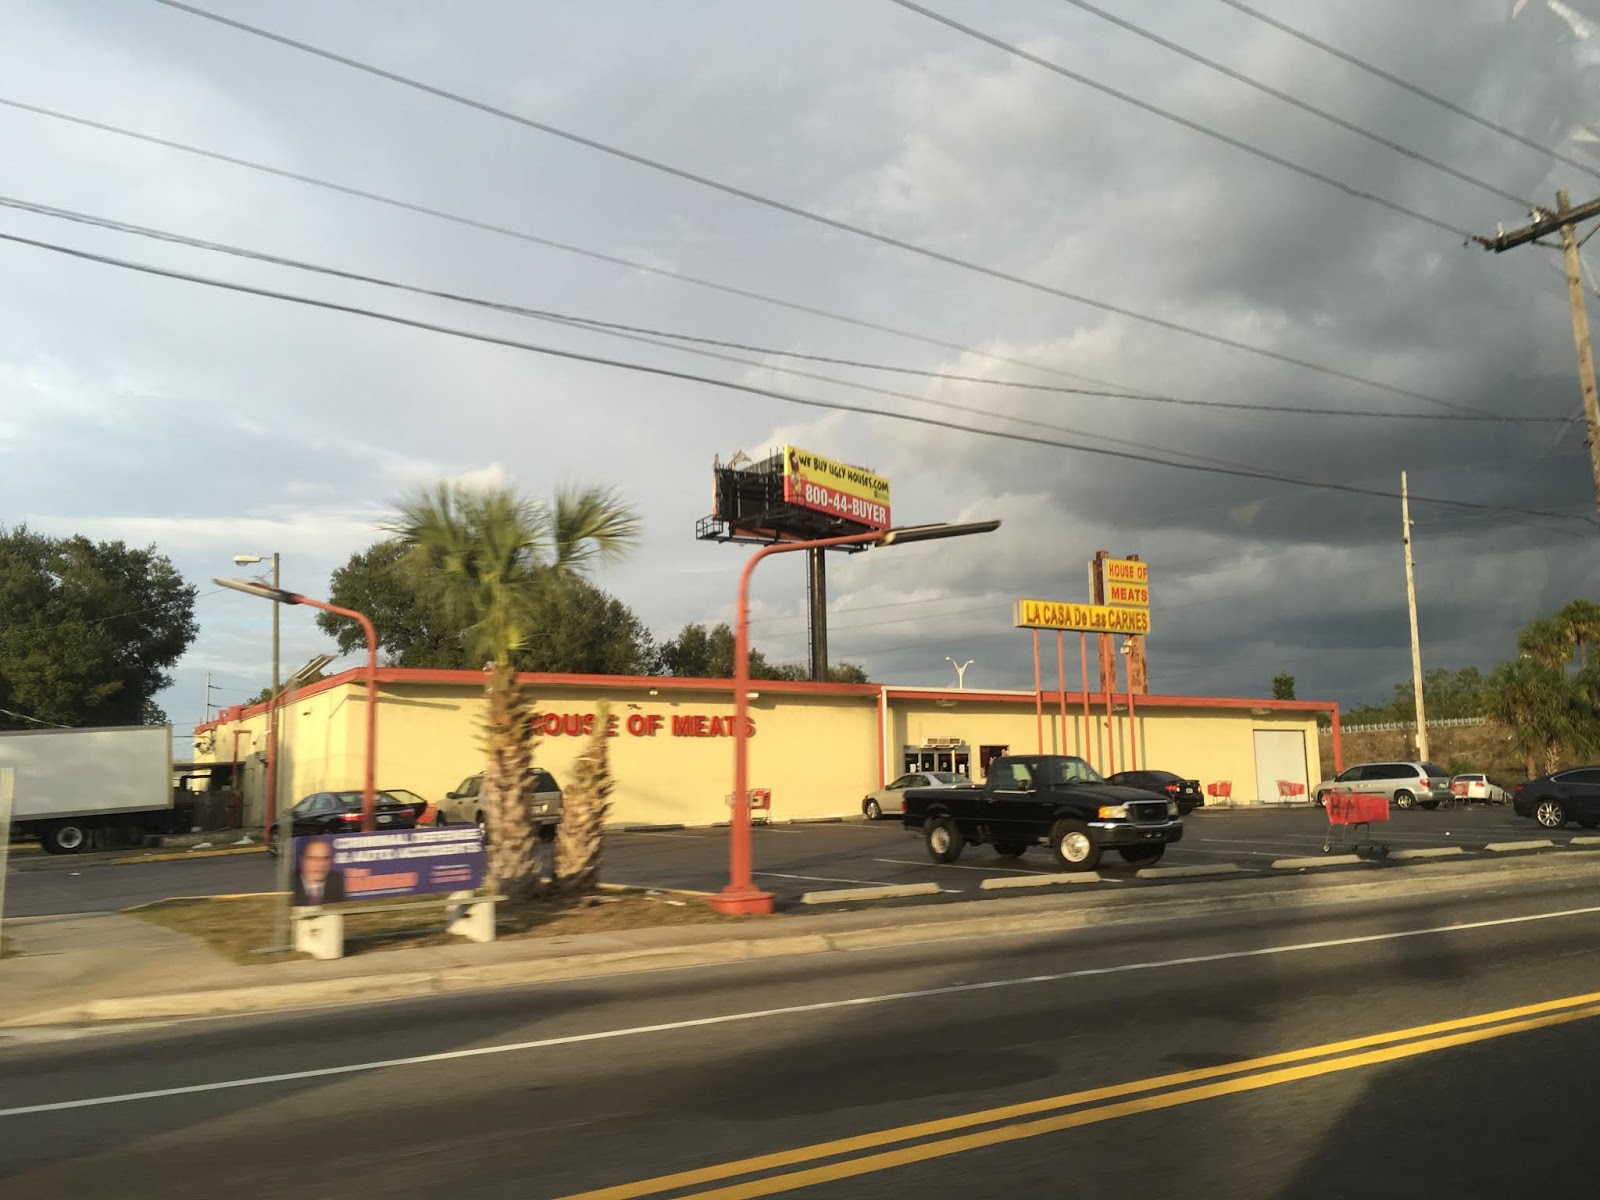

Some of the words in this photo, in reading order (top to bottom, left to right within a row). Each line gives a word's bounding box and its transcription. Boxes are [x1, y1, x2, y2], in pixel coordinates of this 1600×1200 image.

[799, 455, 811, 468] WE
[814, 457, 827, 472] BUY
[829, 464, 846, 479] UGLY
[805, 483, 887, 525] 800-44-BUYER
[1109, 563, 1134, 578] HOUSE
[1137, 567, 1148, 580] OF
[1111, 586, 1148, 602] MEATS
[1026, 602, 1041, 623] LA
[1043, 604, 1072, 626] CASA
[1074, 606, 1087, 627] De
[1089, 608, 1106, 628] Las
[1108, 609, 1148, 632] CARNES
[626, 713, 664, 737] OF
